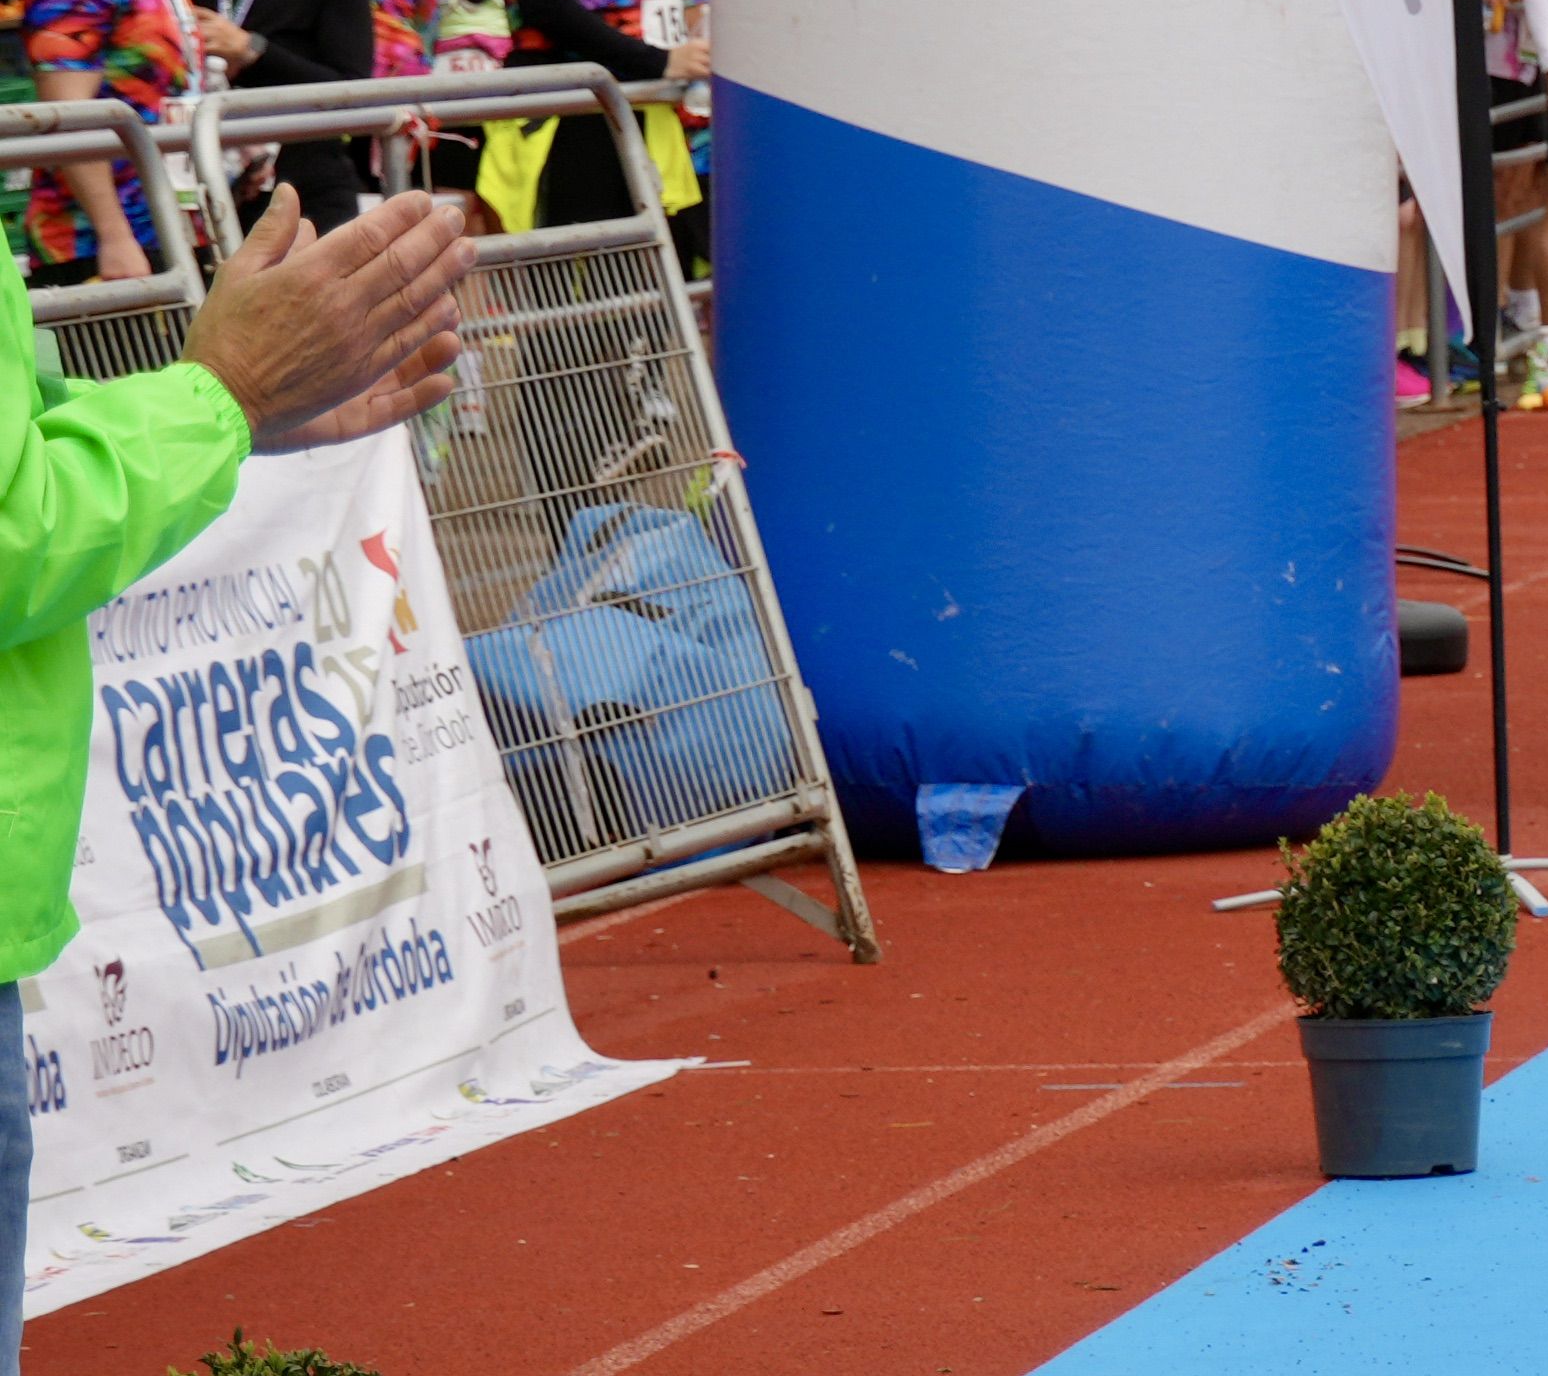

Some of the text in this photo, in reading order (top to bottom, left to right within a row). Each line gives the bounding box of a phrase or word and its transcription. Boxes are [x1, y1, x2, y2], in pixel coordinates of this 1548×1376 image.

[173, 562, 304, 650] PROVINCIAL
[298, 550, 352, 643] 20
[101, 641, 356, 802] carreras
[130, 733, 410, 971] populares
[206, 962, 329, 1080] Diputación
